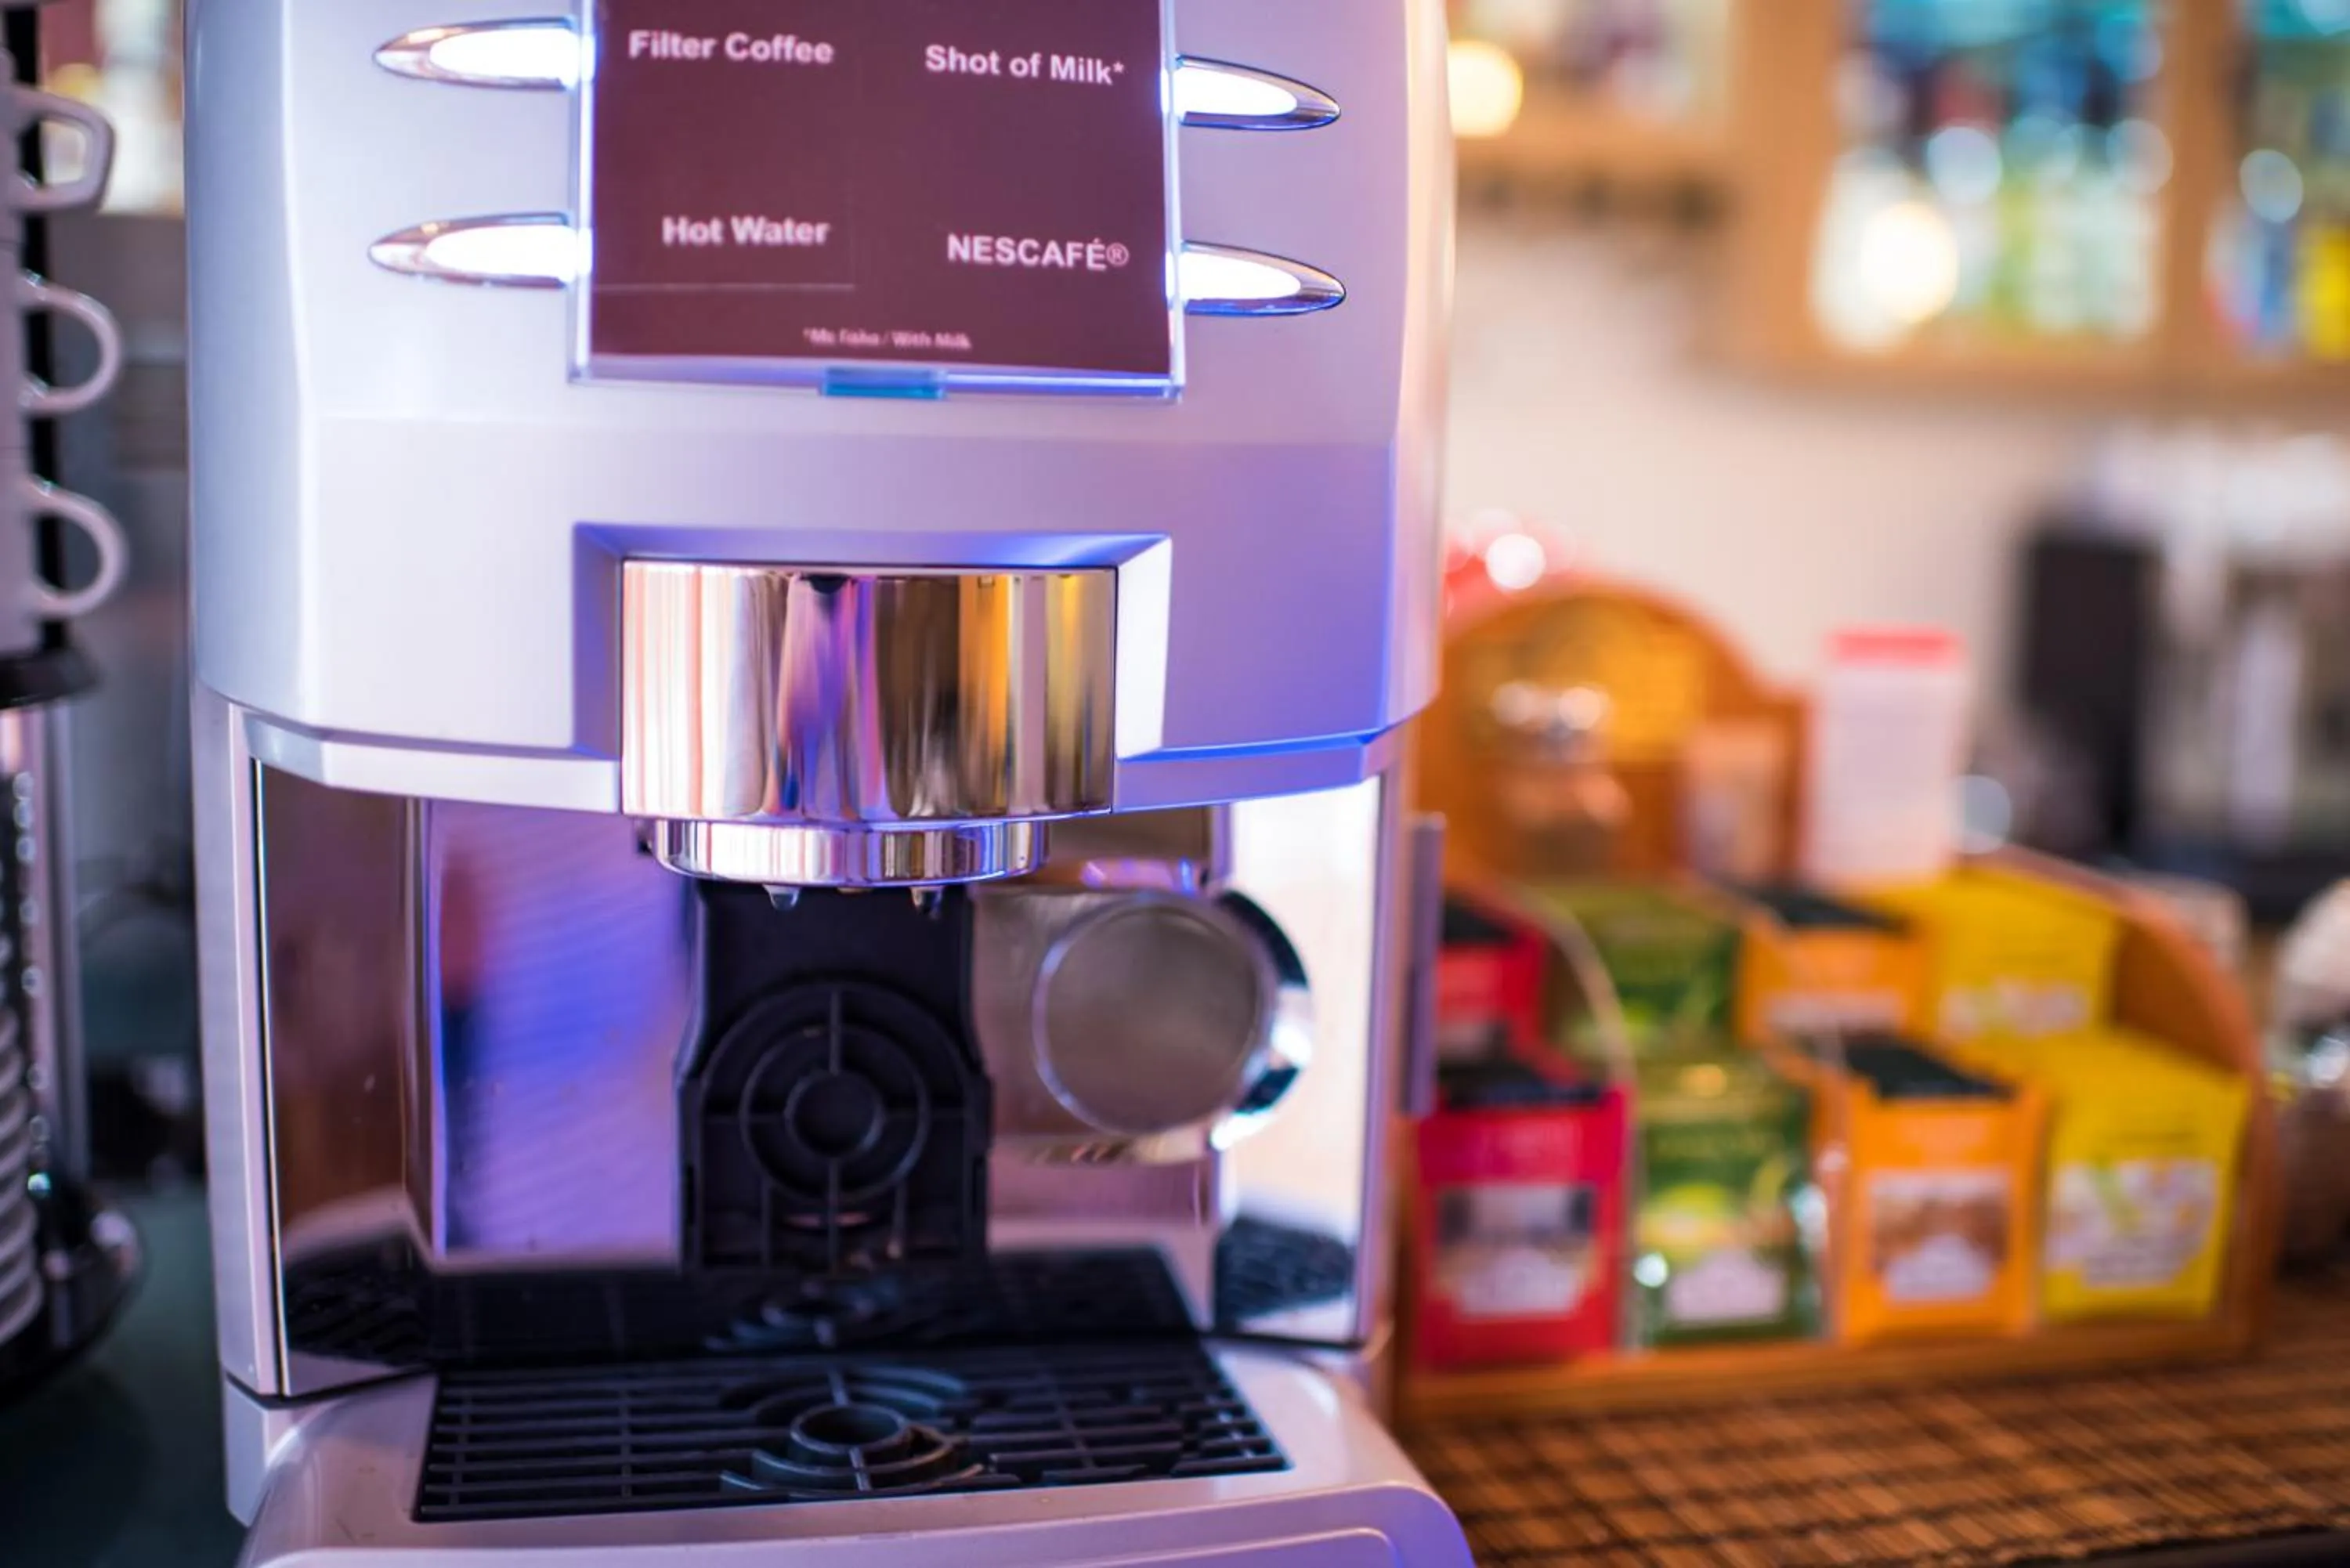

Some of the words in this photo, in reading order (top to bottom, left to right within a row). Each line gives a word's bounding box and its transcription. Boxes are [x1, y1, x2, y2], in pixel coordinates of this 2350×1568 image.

[629, 30, 716, 59] Filter
[725, 32, 834, 64] Coffee
[925, 44, 1001, 75] Shot
[1009, 52, 1042, 78] of
[662, 216, 723, 245] Hot
[731, 215, 830, 245] Water
